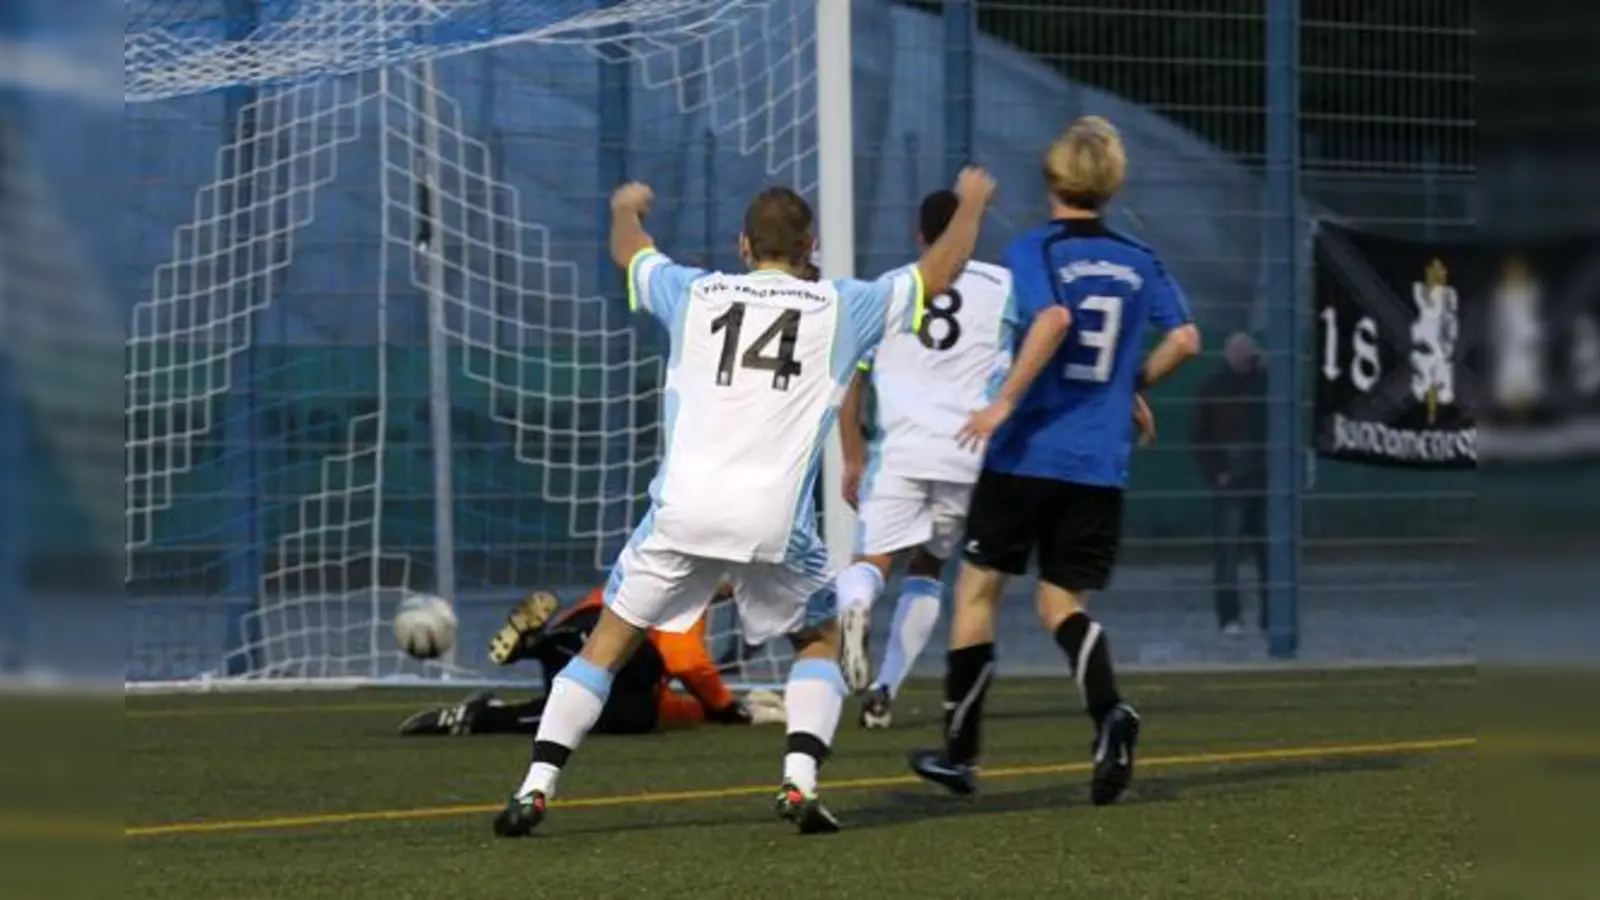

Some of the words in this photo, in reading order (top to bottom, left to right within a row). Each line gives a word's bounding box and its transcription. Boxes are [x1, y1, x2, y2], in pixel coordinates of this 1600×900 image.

[710, 301, 802, 391] 14
[919, 286, 962, 351] 8
[1064, 296, 1121, 382] 3
[1320, 305, 1381, 392] 18
